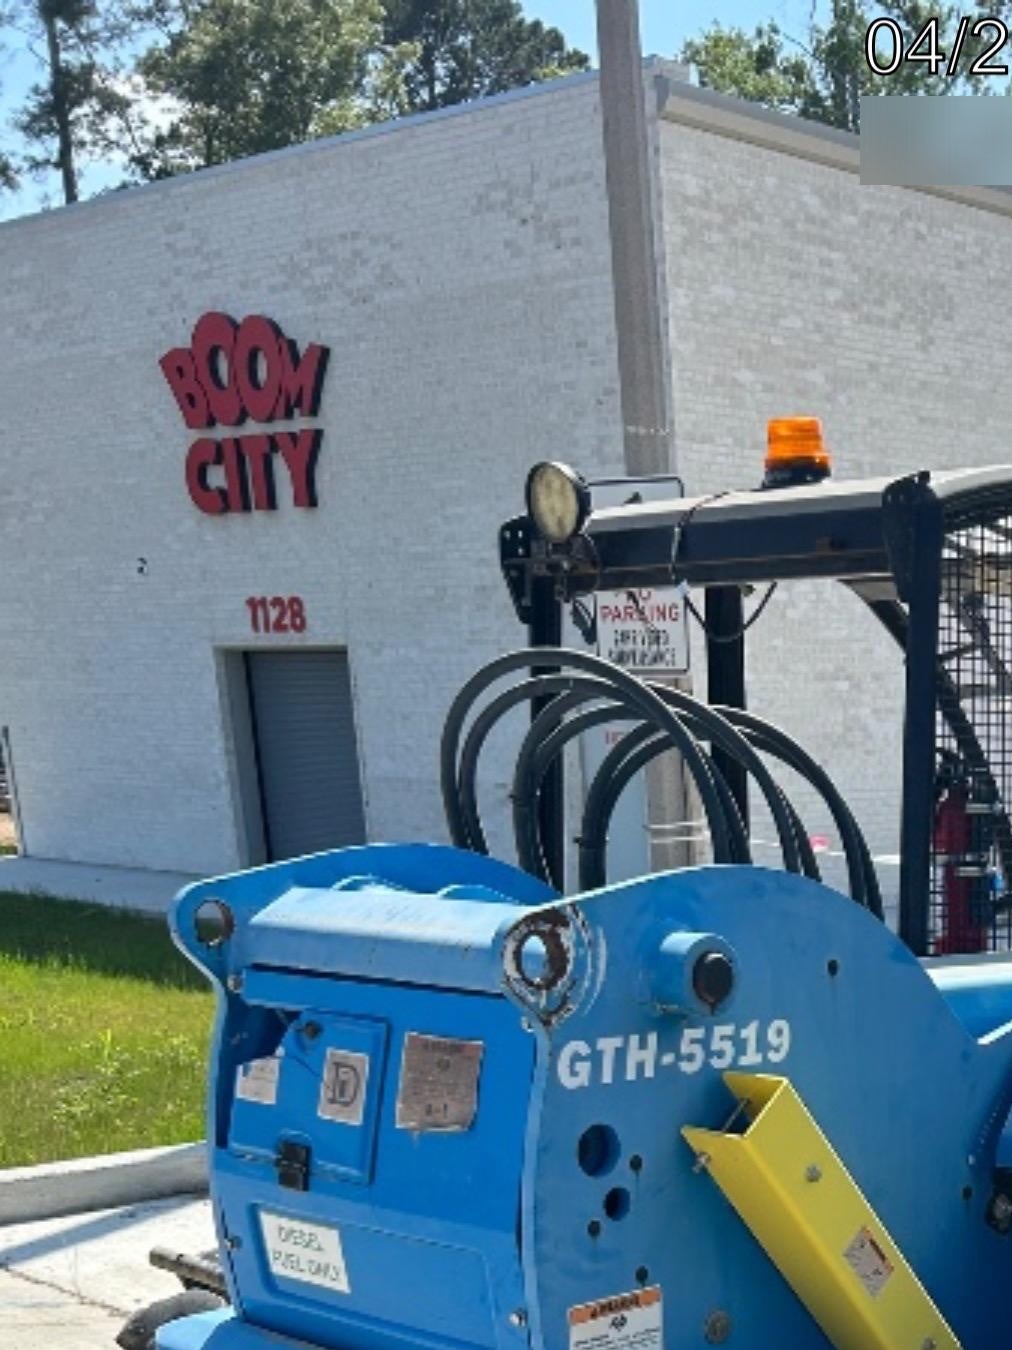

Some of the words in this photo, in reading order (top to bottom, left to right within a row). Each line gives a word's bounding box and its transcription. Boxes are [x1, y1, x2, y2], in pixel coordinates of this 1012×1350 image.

[158, 311, 330, 430] BOOM
[185, 428, 324, 516] CITY
[246, 595, 308, 634] 1128
[556, 1017, 792, 1091] GTH-5519
